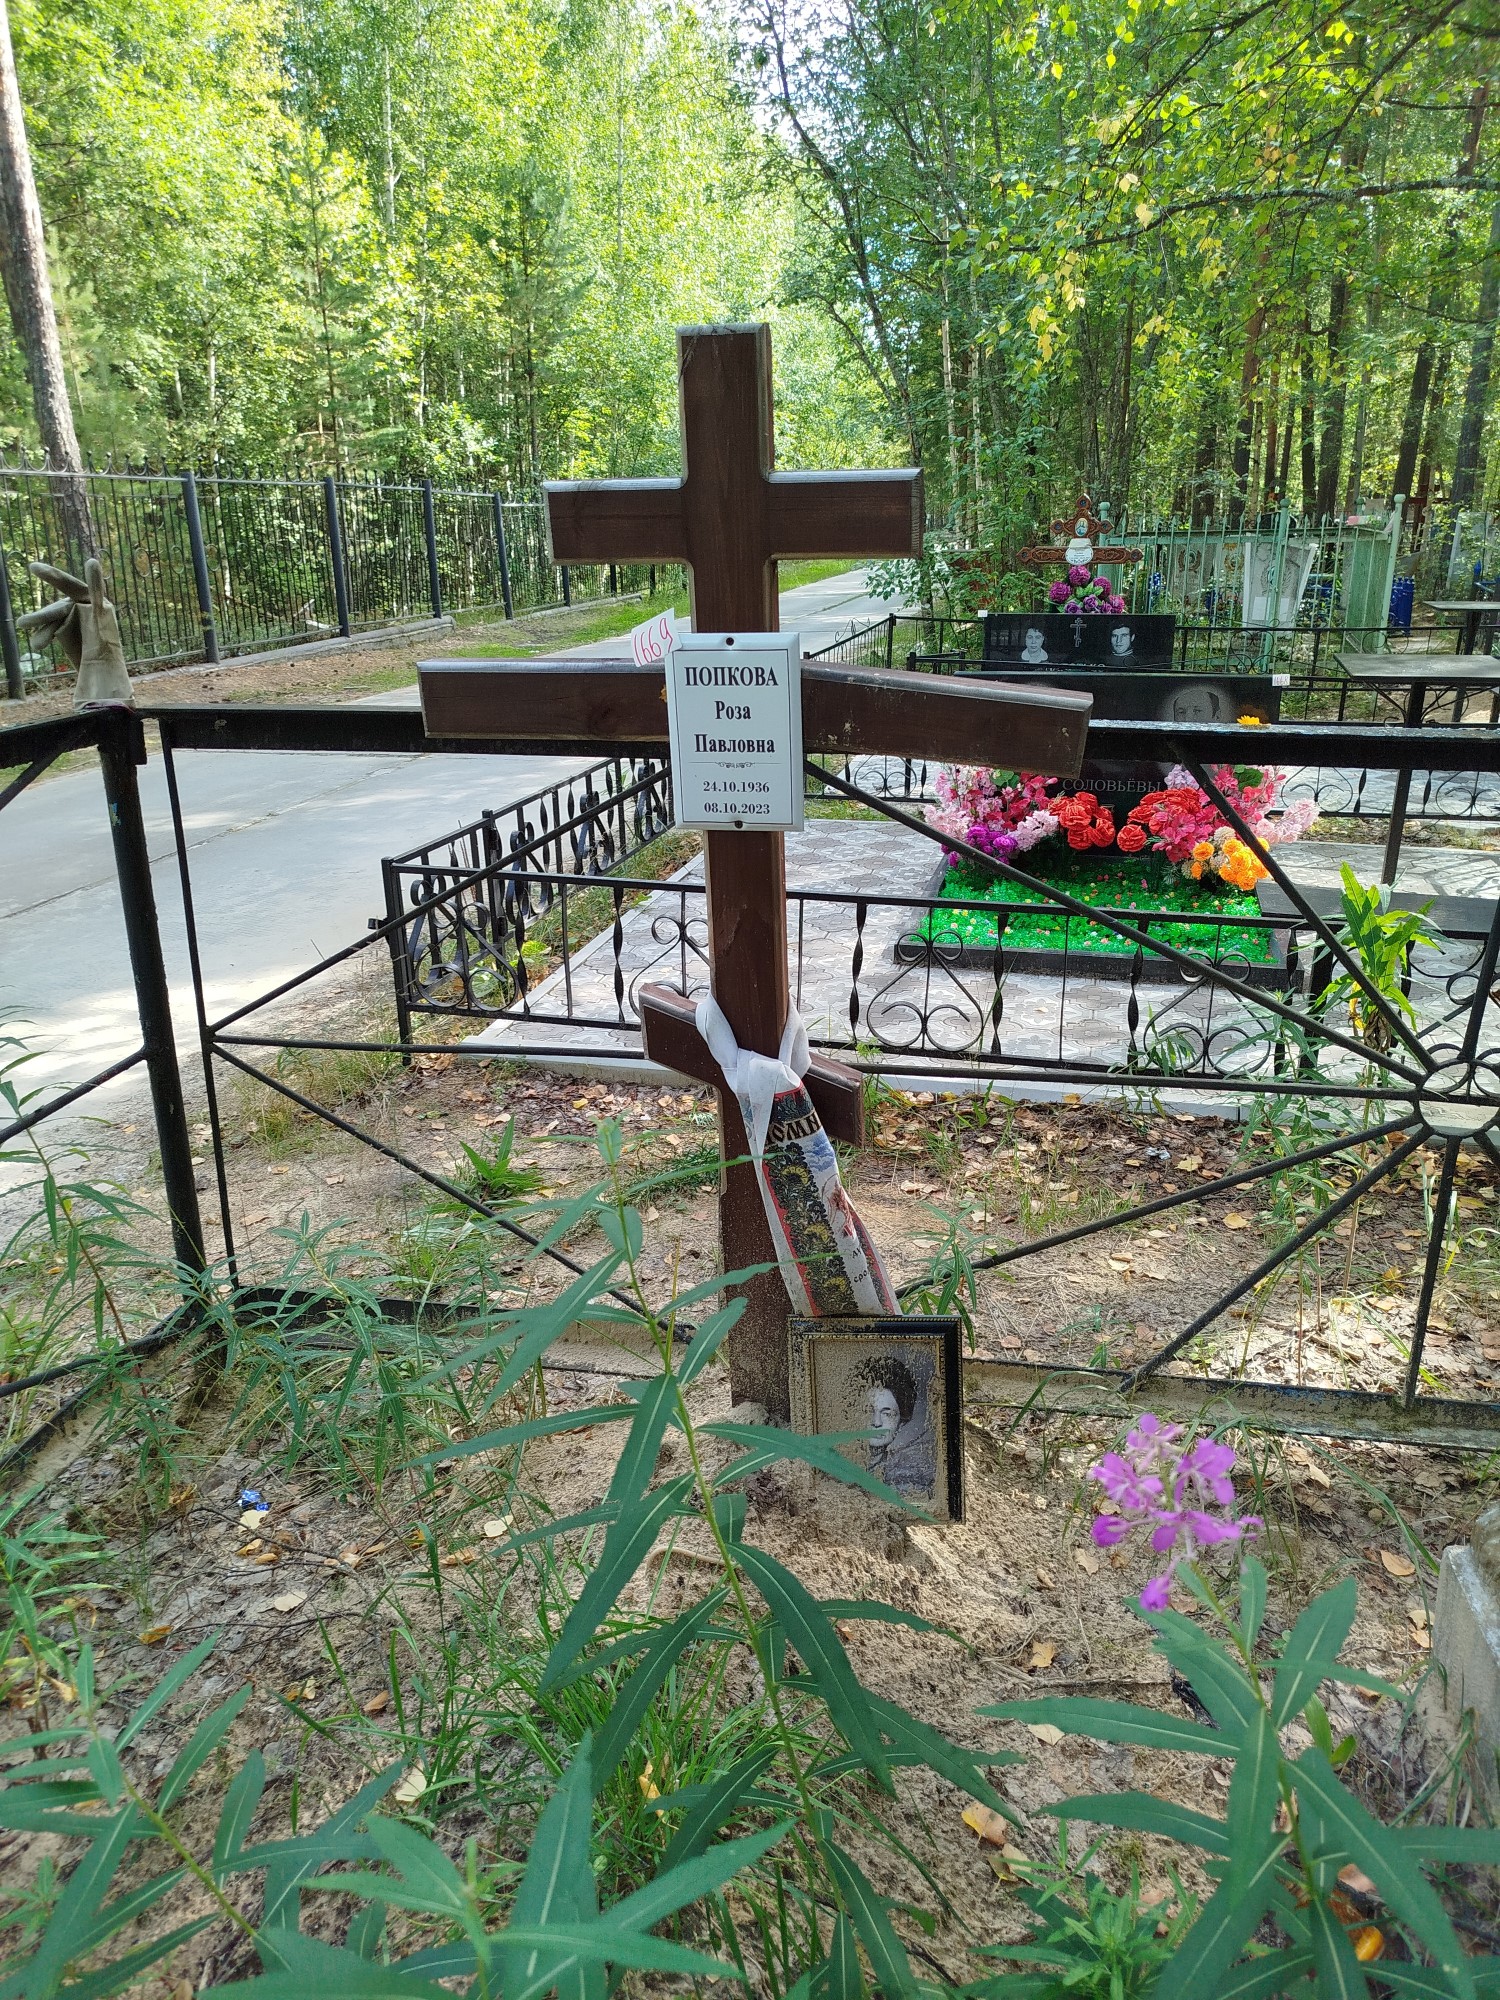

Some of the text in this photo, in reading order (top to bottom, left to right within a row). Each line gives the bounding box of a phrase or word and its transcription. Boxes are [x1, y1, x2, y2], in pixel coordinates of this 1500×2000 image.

[633, 617, 674, 666] 1669
[684, 666, 779, 687] ПОПКОВА
[714, 700, 752, 720] Роза
[694, 733, 776, 754] Павловна
[703, 781, 770, 793] 24.10.1936
[1062, 778, 1162, 793] СОЛОВЬЁВЫ
[703, 802, 770, 815] 08.10.2023
